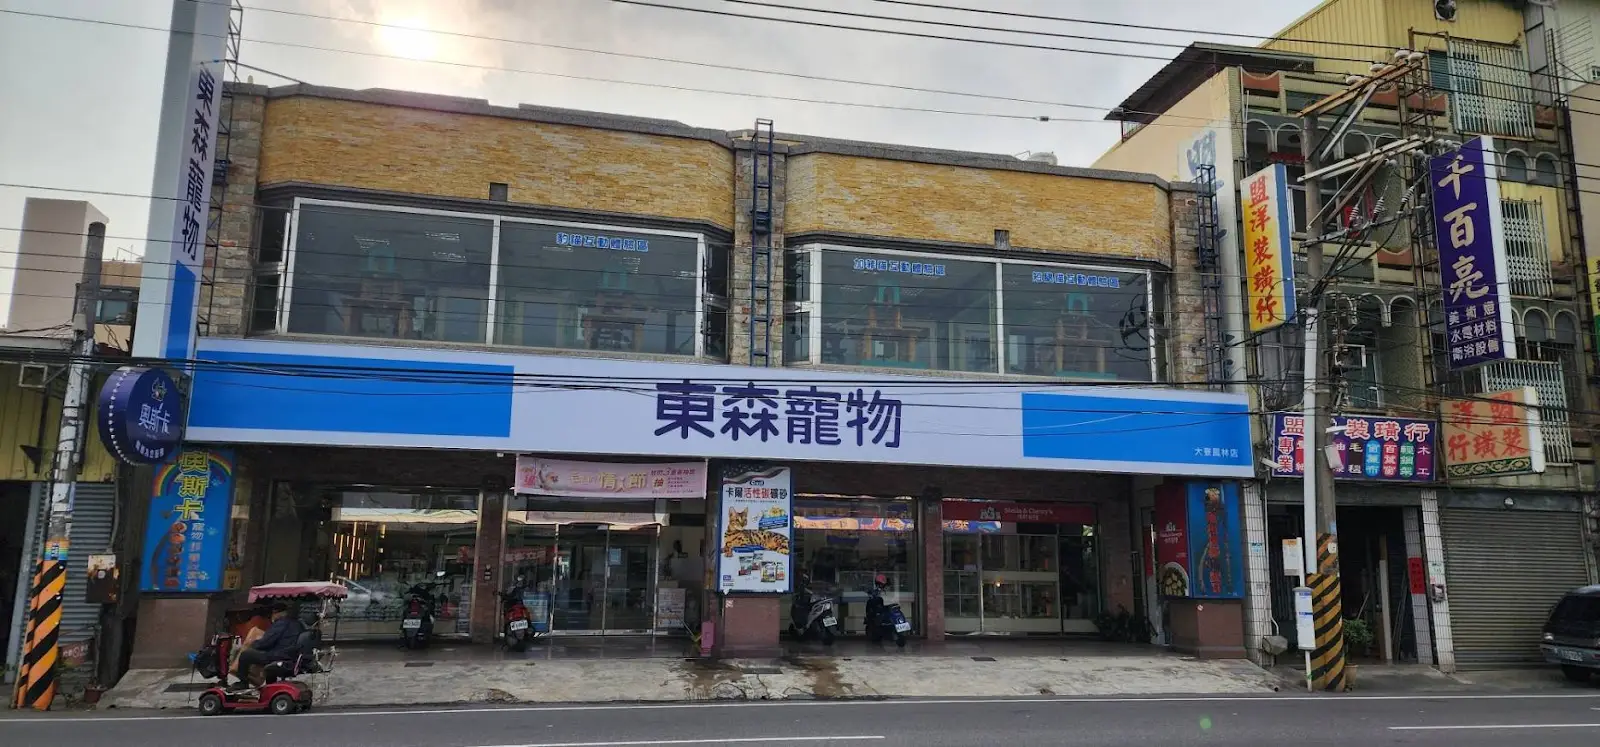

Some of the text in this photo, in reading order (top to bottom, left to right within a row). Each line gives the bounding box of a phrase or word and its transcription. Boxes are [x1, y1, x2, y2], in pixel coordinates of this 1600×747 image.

[182, 67, 216, 261] 東森寵物
[1438, 154, 1490, 304] 千百亮
[1450, 318, 1497, 343] 水電材料
[654, 379, 902, 449] 東森寵物
[1277, 436, 1294, 473] 專業
[1417, 446, 1431, 476] 木工
